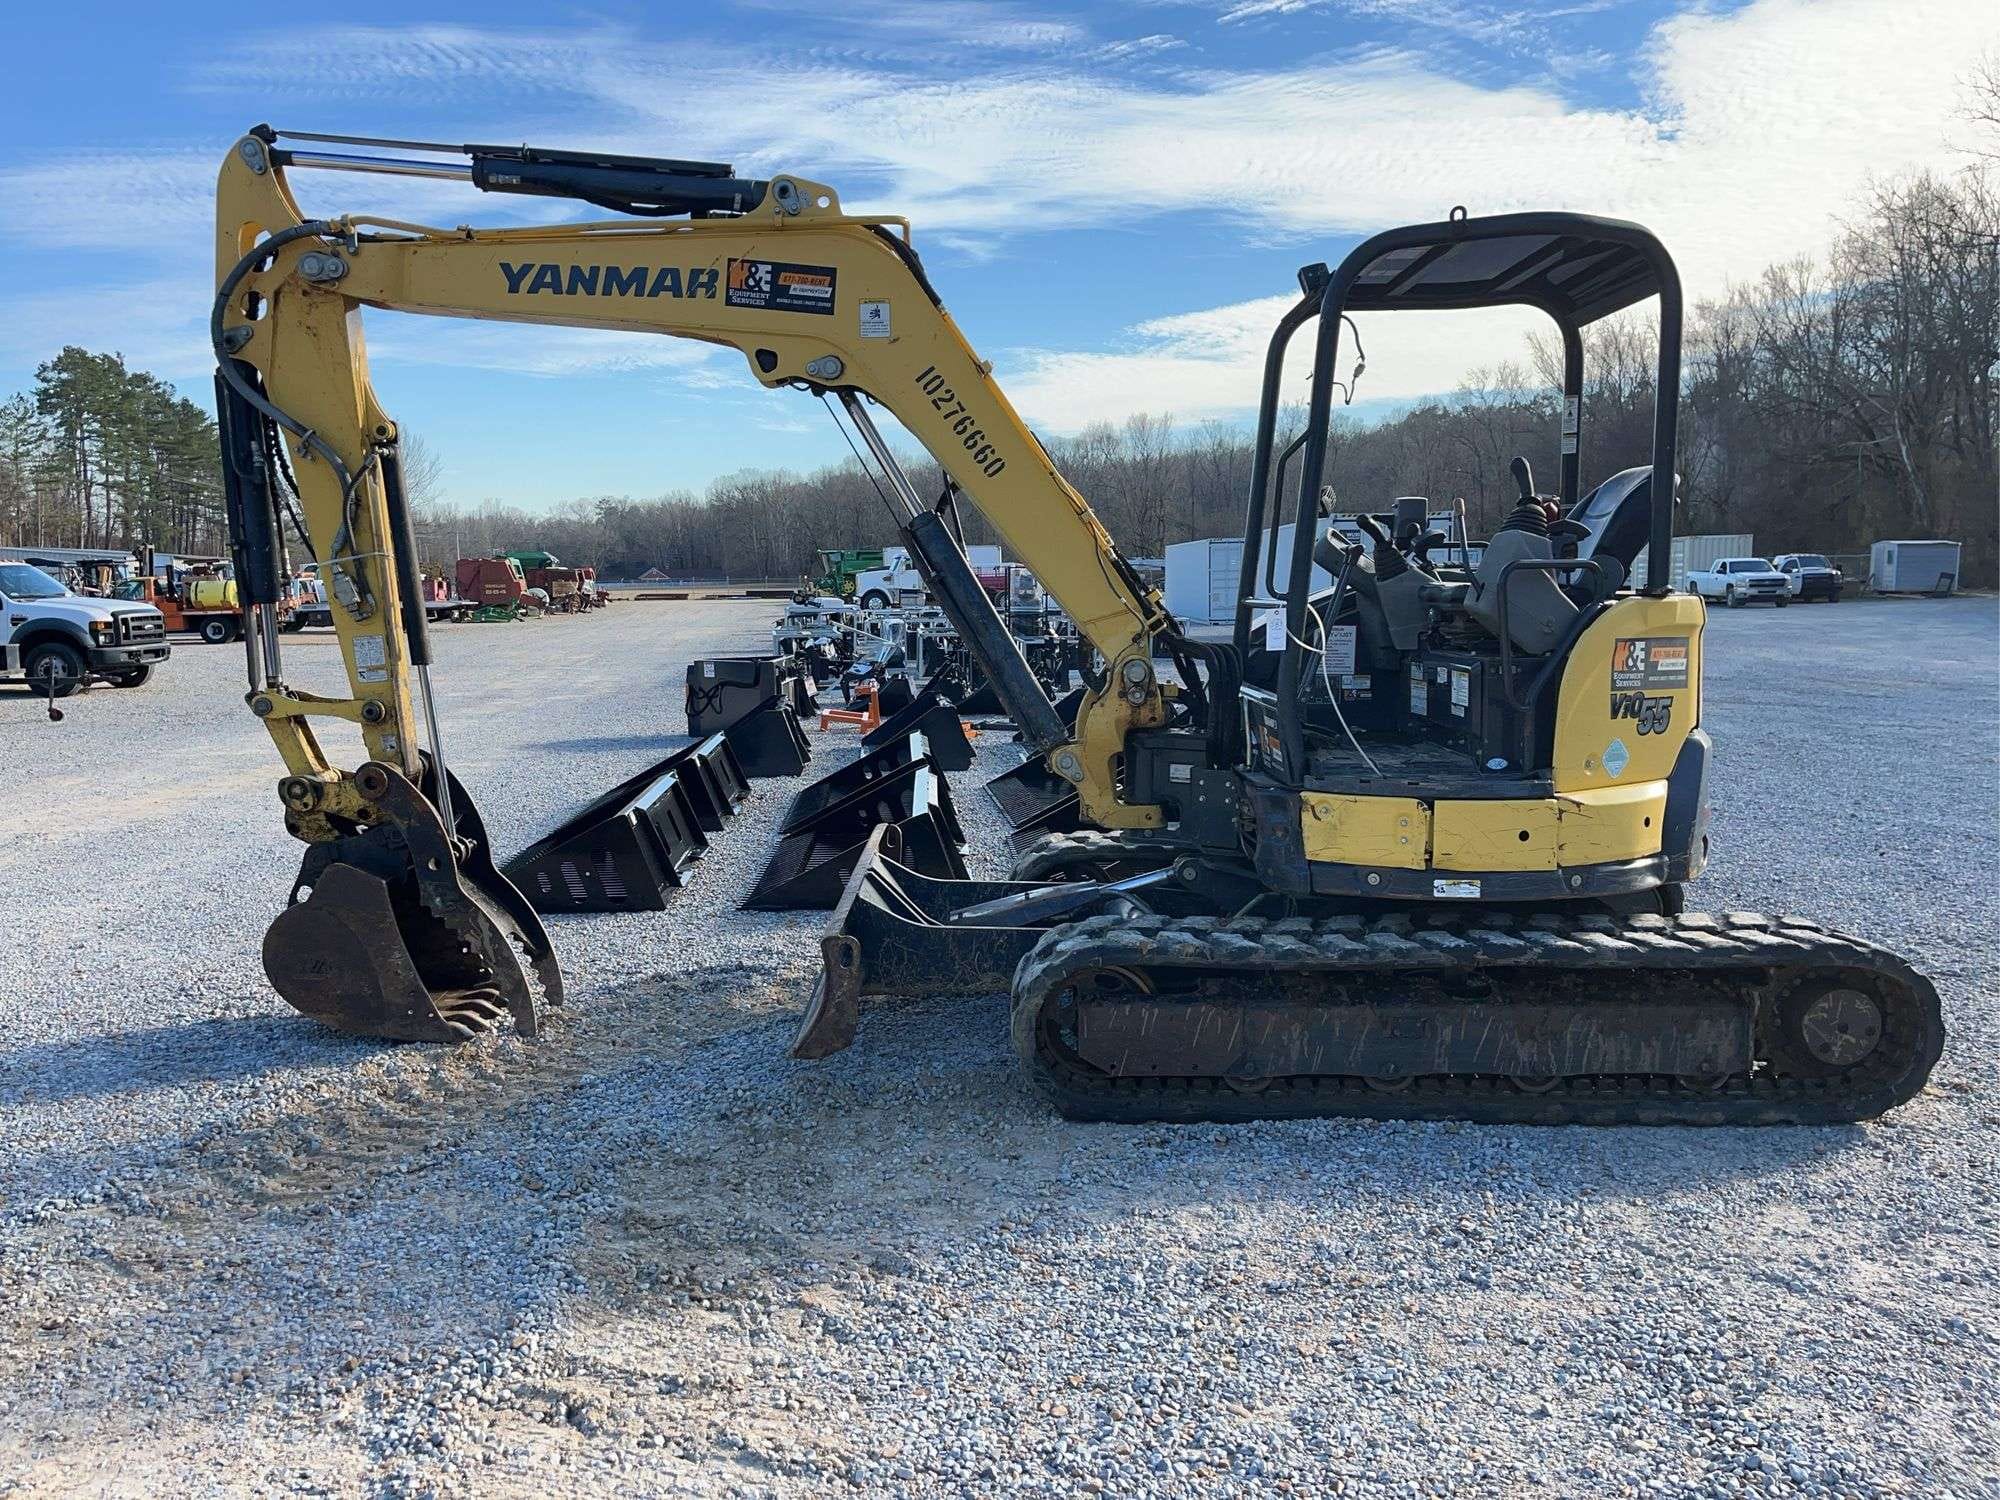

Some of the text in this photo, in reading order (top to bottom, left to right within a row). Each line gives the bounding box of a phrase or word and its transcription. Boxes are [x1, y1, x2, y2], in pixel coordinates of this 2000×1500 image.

[499, 262, 720, 299] YANMAR
[729, 262, 772, 292] H&E
[729, 289, 771, 300] EQUIPMENT
[731, 296, 766, 306] SERVICES
[915, 366, 1006, 478] 10276660
[1613, 641, 1646, 671] H&E
